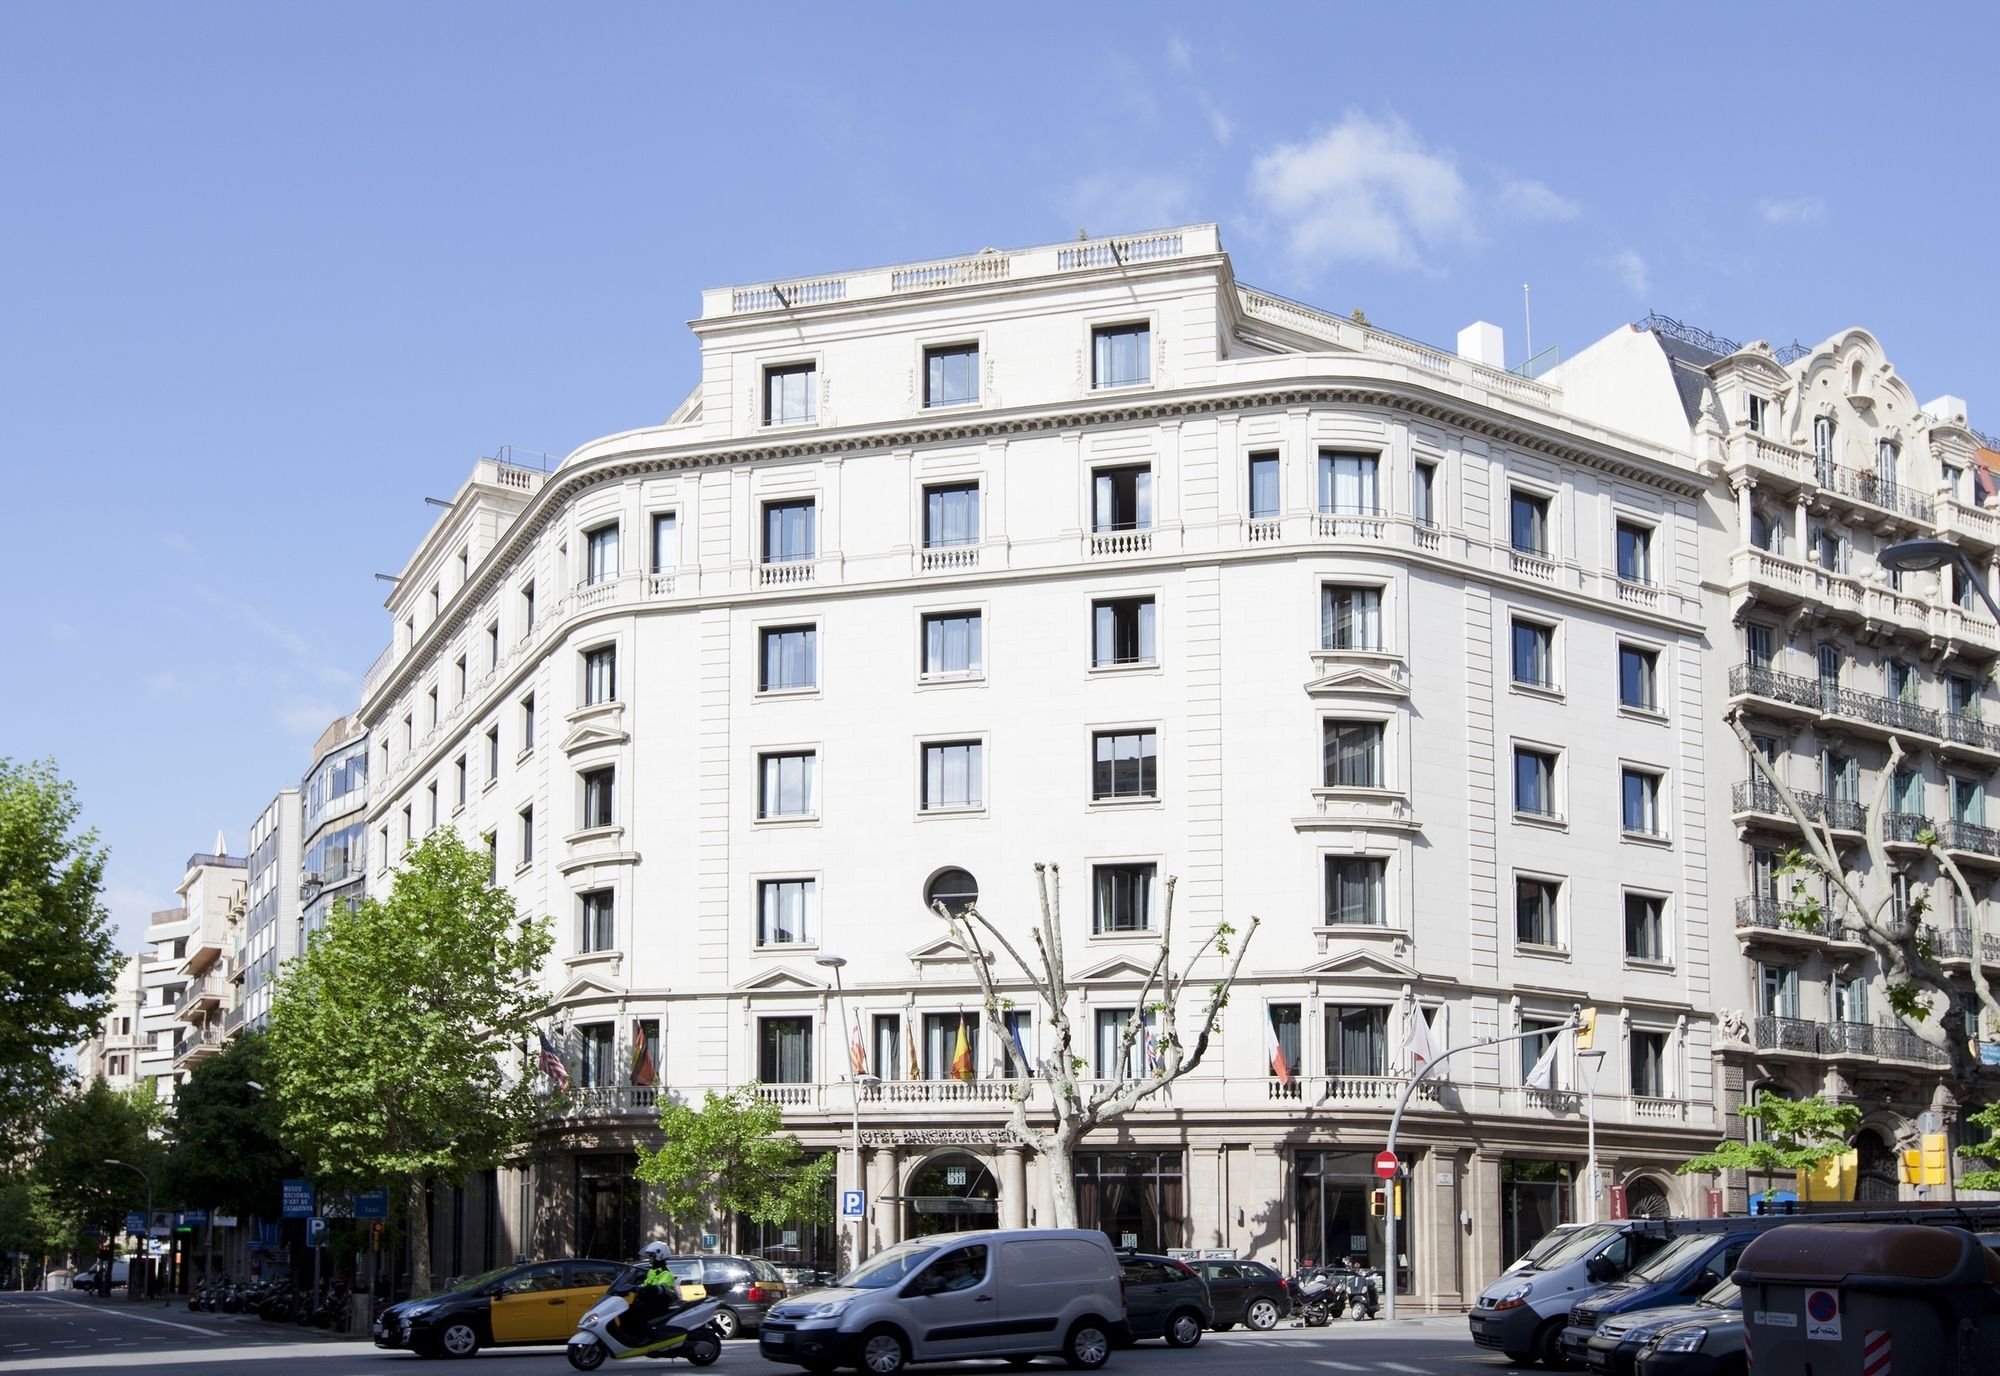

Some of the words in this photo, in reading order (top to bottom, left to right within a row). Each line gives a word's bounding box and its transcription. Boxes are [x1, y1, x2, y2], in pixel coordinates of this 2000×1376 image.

[903, 1129, 984, 1144] BARCELONA
[847, 1193, 860, 1213] P
[311, 1220, 325, 1235] P
